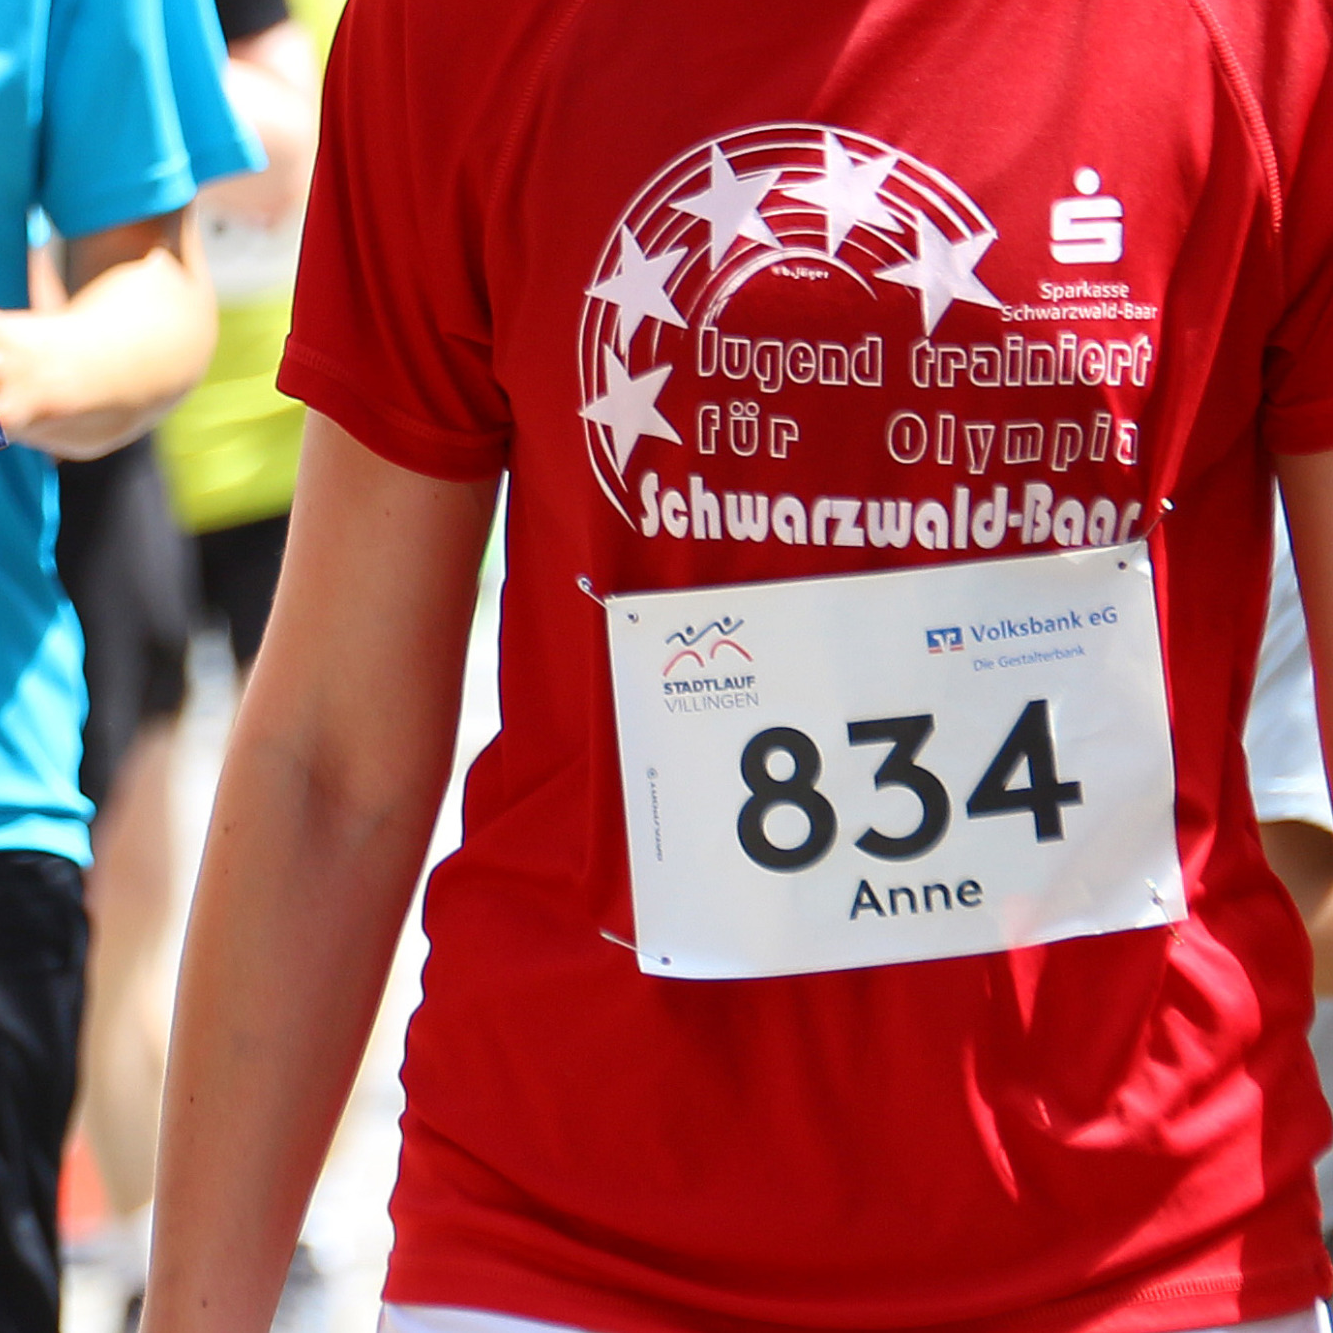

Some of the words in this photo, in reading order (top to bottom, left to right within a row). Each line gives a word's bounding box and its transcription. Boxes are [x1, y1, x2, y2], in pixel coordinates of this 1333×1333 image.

[1039, 281, 1130, 302] Sparkasse
[1001, 303, 1158, 322] Schwarzwald-Baar
[698, 326, 883, 394] Jugend
[911, 333, 1151, 388] trainiert
[696, 401, 800, 459] für
[887, 411, 1138, 474] Olympia
[639, 470, 1142, 549] Schwarzwald-Baar
[970, 610, 1083, 643] Volksbank
[1088, 605, 1118, 626] eG
[973, 657, 995, 672] Die
[997, 645, 1086, 669] Gestalterbank
[663, 675, 756, 695] STADTLAUF
[663, 692, 760, 714] VILLINGEN
[736, 698, 1085, 875] 834
[849, 878, 984, 921] Anne
